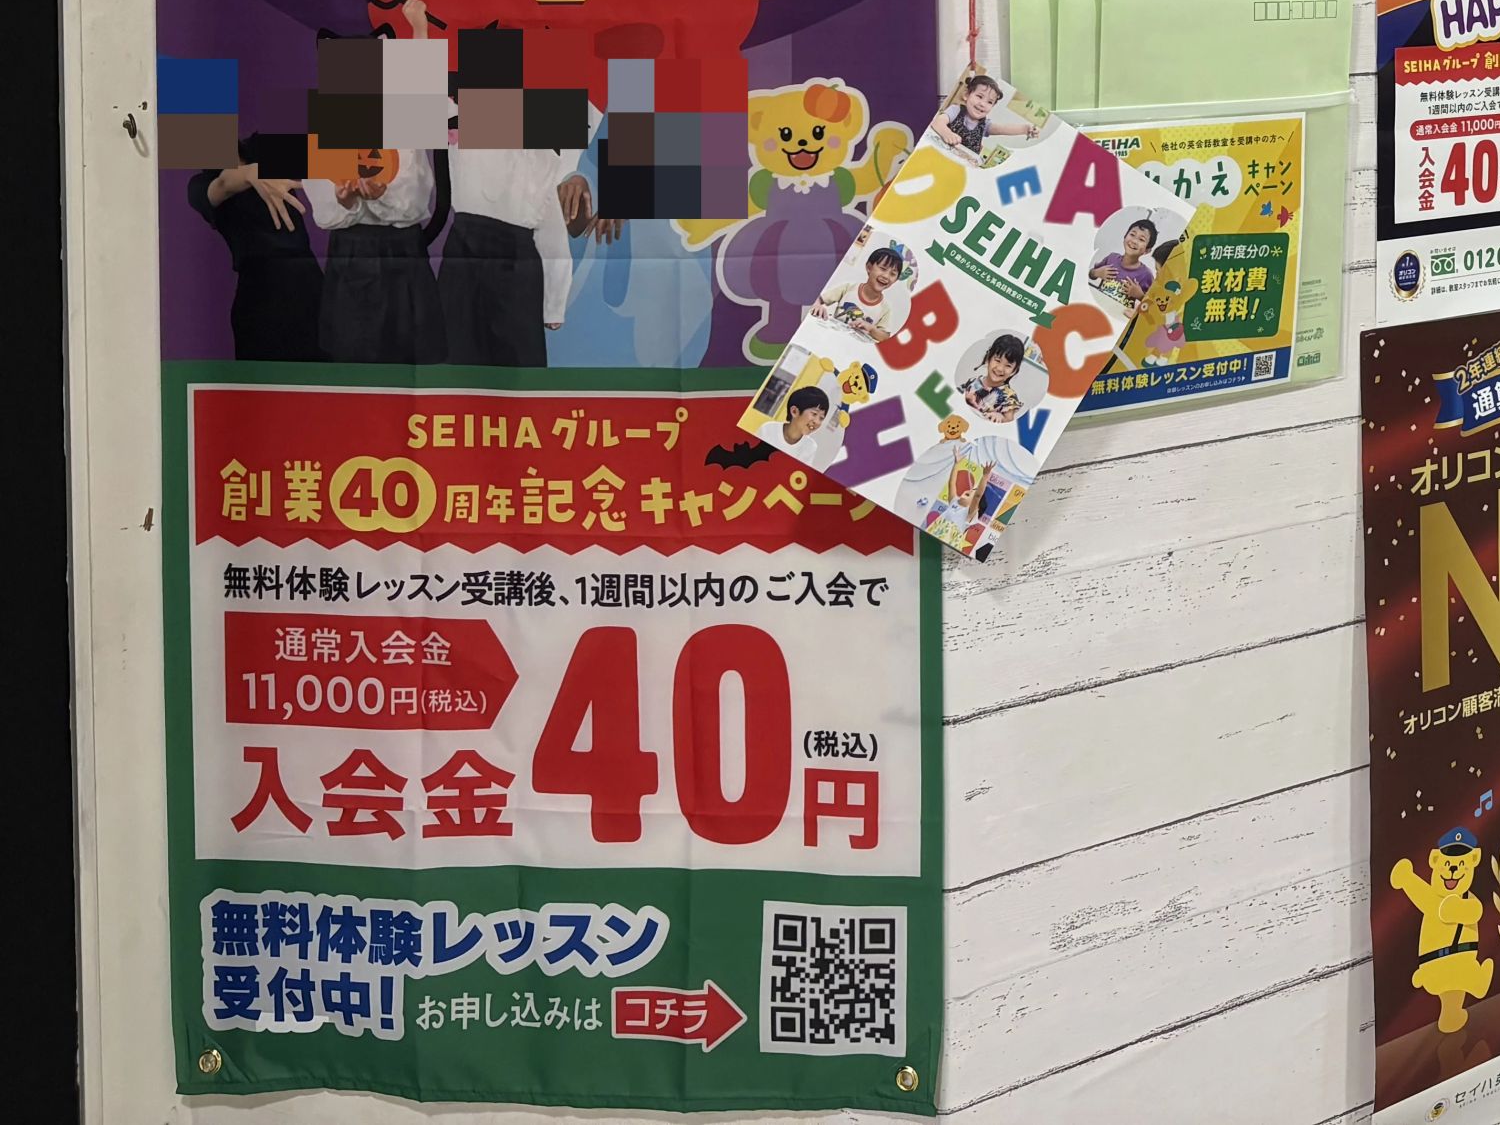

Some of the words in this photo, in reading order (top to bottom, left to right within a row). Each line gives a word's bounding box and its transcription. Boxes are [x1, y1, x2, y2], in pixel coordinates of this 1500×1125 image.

[1404, 53, 1480, 74] SEIHAグループ
[1161, 134, 1286, 151] 他社の英会話教室を受講中の方へ
[1416, 122, 1458, 136] 通常入会金
[1244, 180, 1294, 196] ペーン
[1247, 159, 1292, 179] キャン
[1418, 146, 1435, 212] 入会金
[1440, 139, 1499, 206] 40
[939, 195, 1077, 307] SEIHA
[1210, 244, 1270, 261] 初年度分の
[1201, 267, 1268, 294] 教材費
[1203, 297, 1261, 323] 無料!
[1090, 357, 1248, 396] 無料体験レッスン受付中!
[407, 406, 689, 451] SEIHAグループ
[222, 562, 890, 610] 無料体験レッスン受講後、1週間以内のご入会で
[274, 627, 453, 666] 通常入会金
[241, 670, 488, 718] 11,000円(税込)
[531, 622, 793, 845] 40
[803, 730, 879, 762] (税込)
[230, 744, 516, 841] 入会金
[804, 768, 880, 851] 円
[209, 897, 663, 967] 無料体験レッスン
[213, 965, 398, 1030] 受付中!
[415, 991, 603, 1031] お申し込みは
[625, 995, 709, 1033] コチラ
